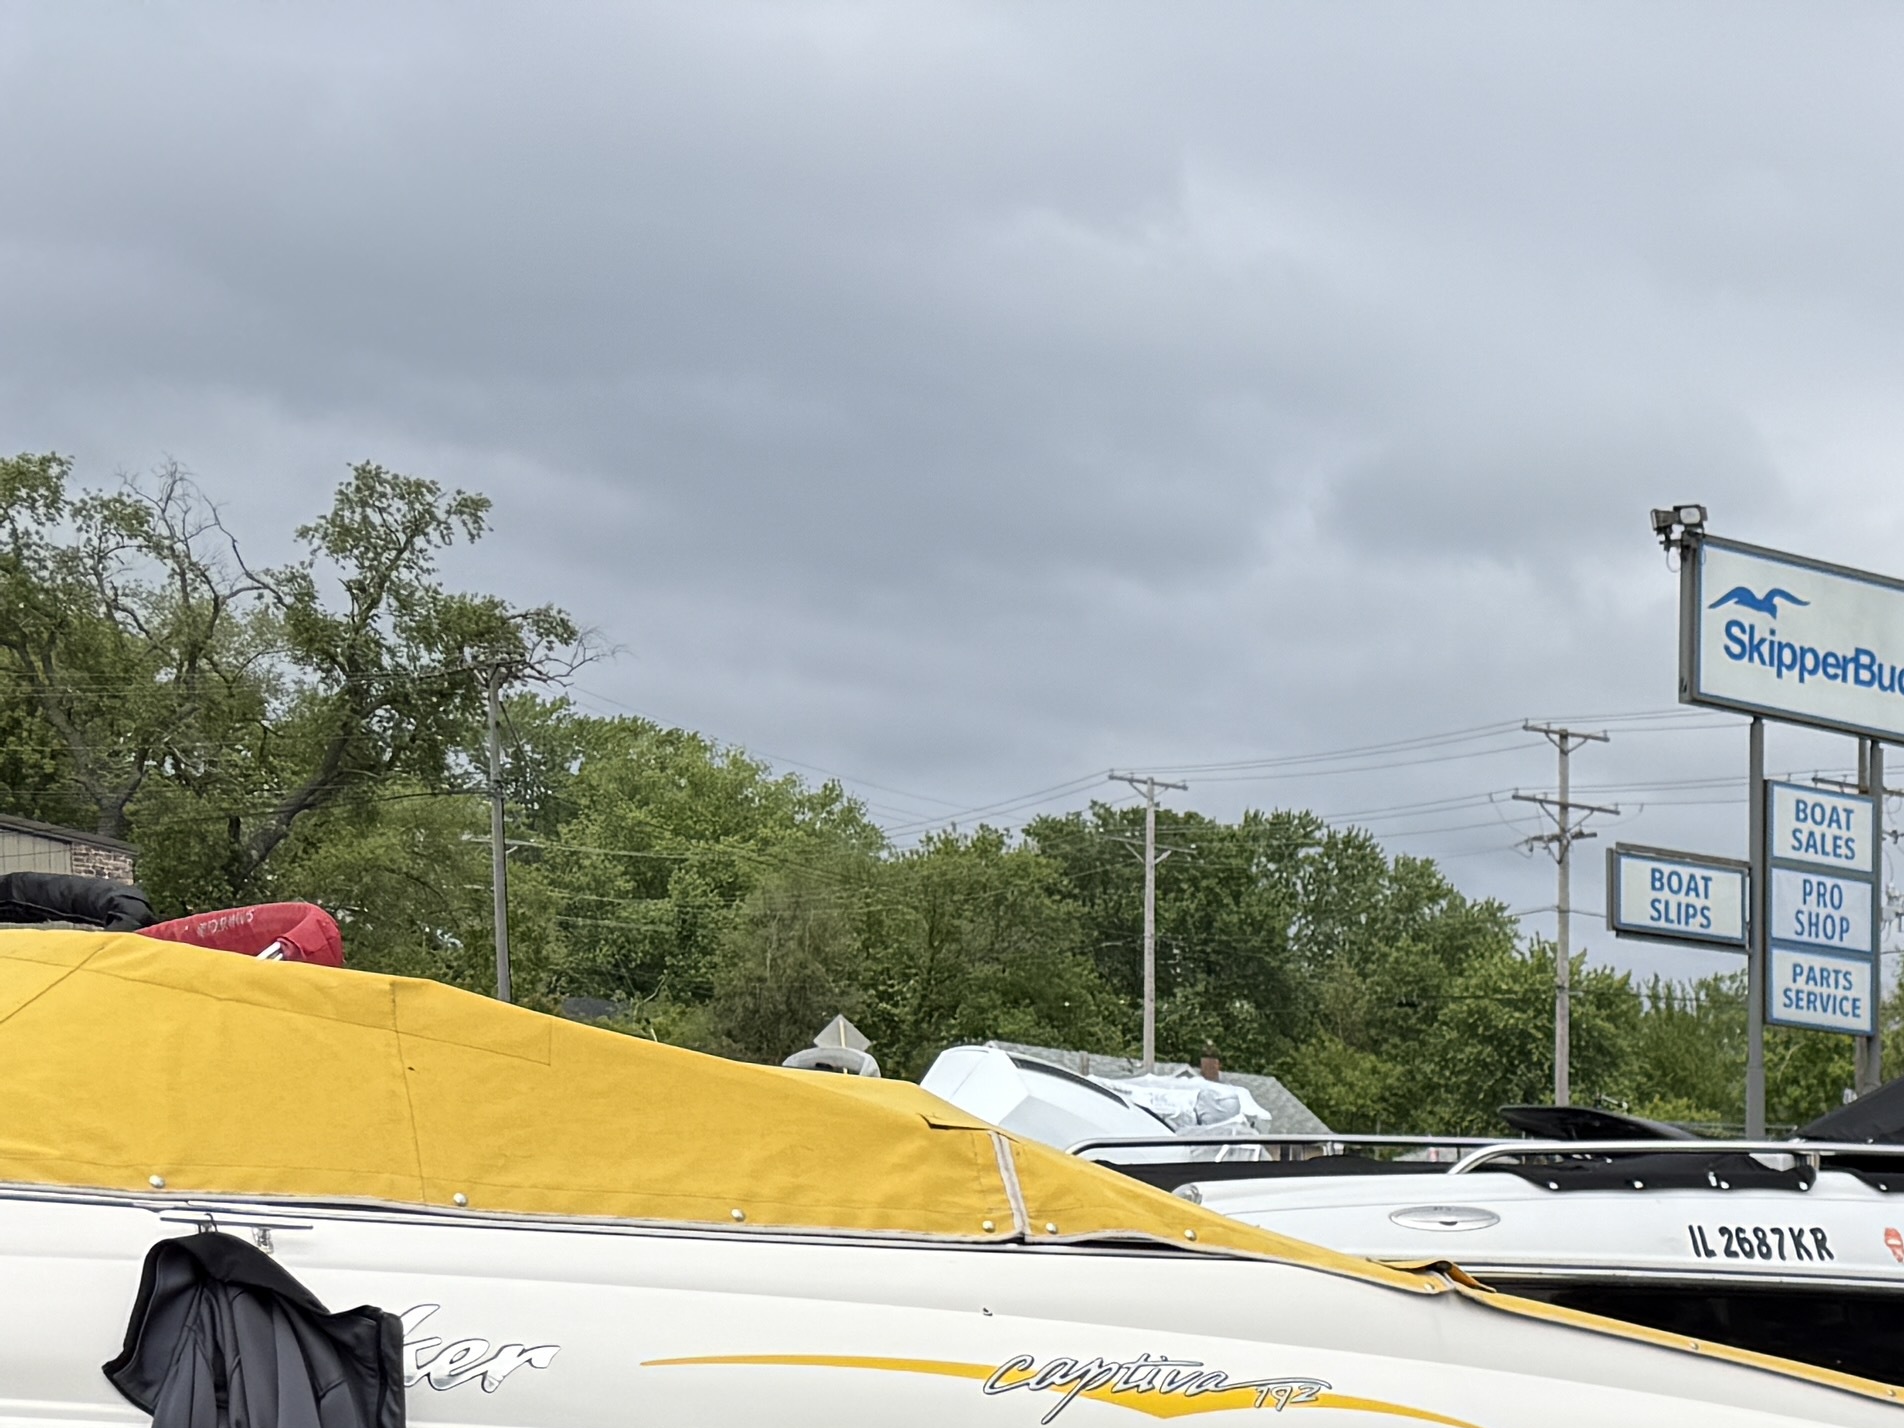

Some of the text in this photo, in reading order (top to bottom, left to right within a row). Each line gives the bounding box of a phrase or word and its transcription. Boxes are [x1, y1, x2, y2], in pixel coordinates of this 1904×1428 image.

[1795, 799, 1854, 832] BOAT
[1791, 828, 1856, 861] SALES
[1649, 868, 1713, 900] BOAT
[1802, 878, 1843, 911] PRO
[1649, 898, 1712, 930] SLIPS
[1794, 910, 1850, 942] SHOP
[1792, 963, 1853, 991] PARTS
[1782, 988, 1861, 1018] SERVICE
[1253, 1384, 1322, 1413] 192
